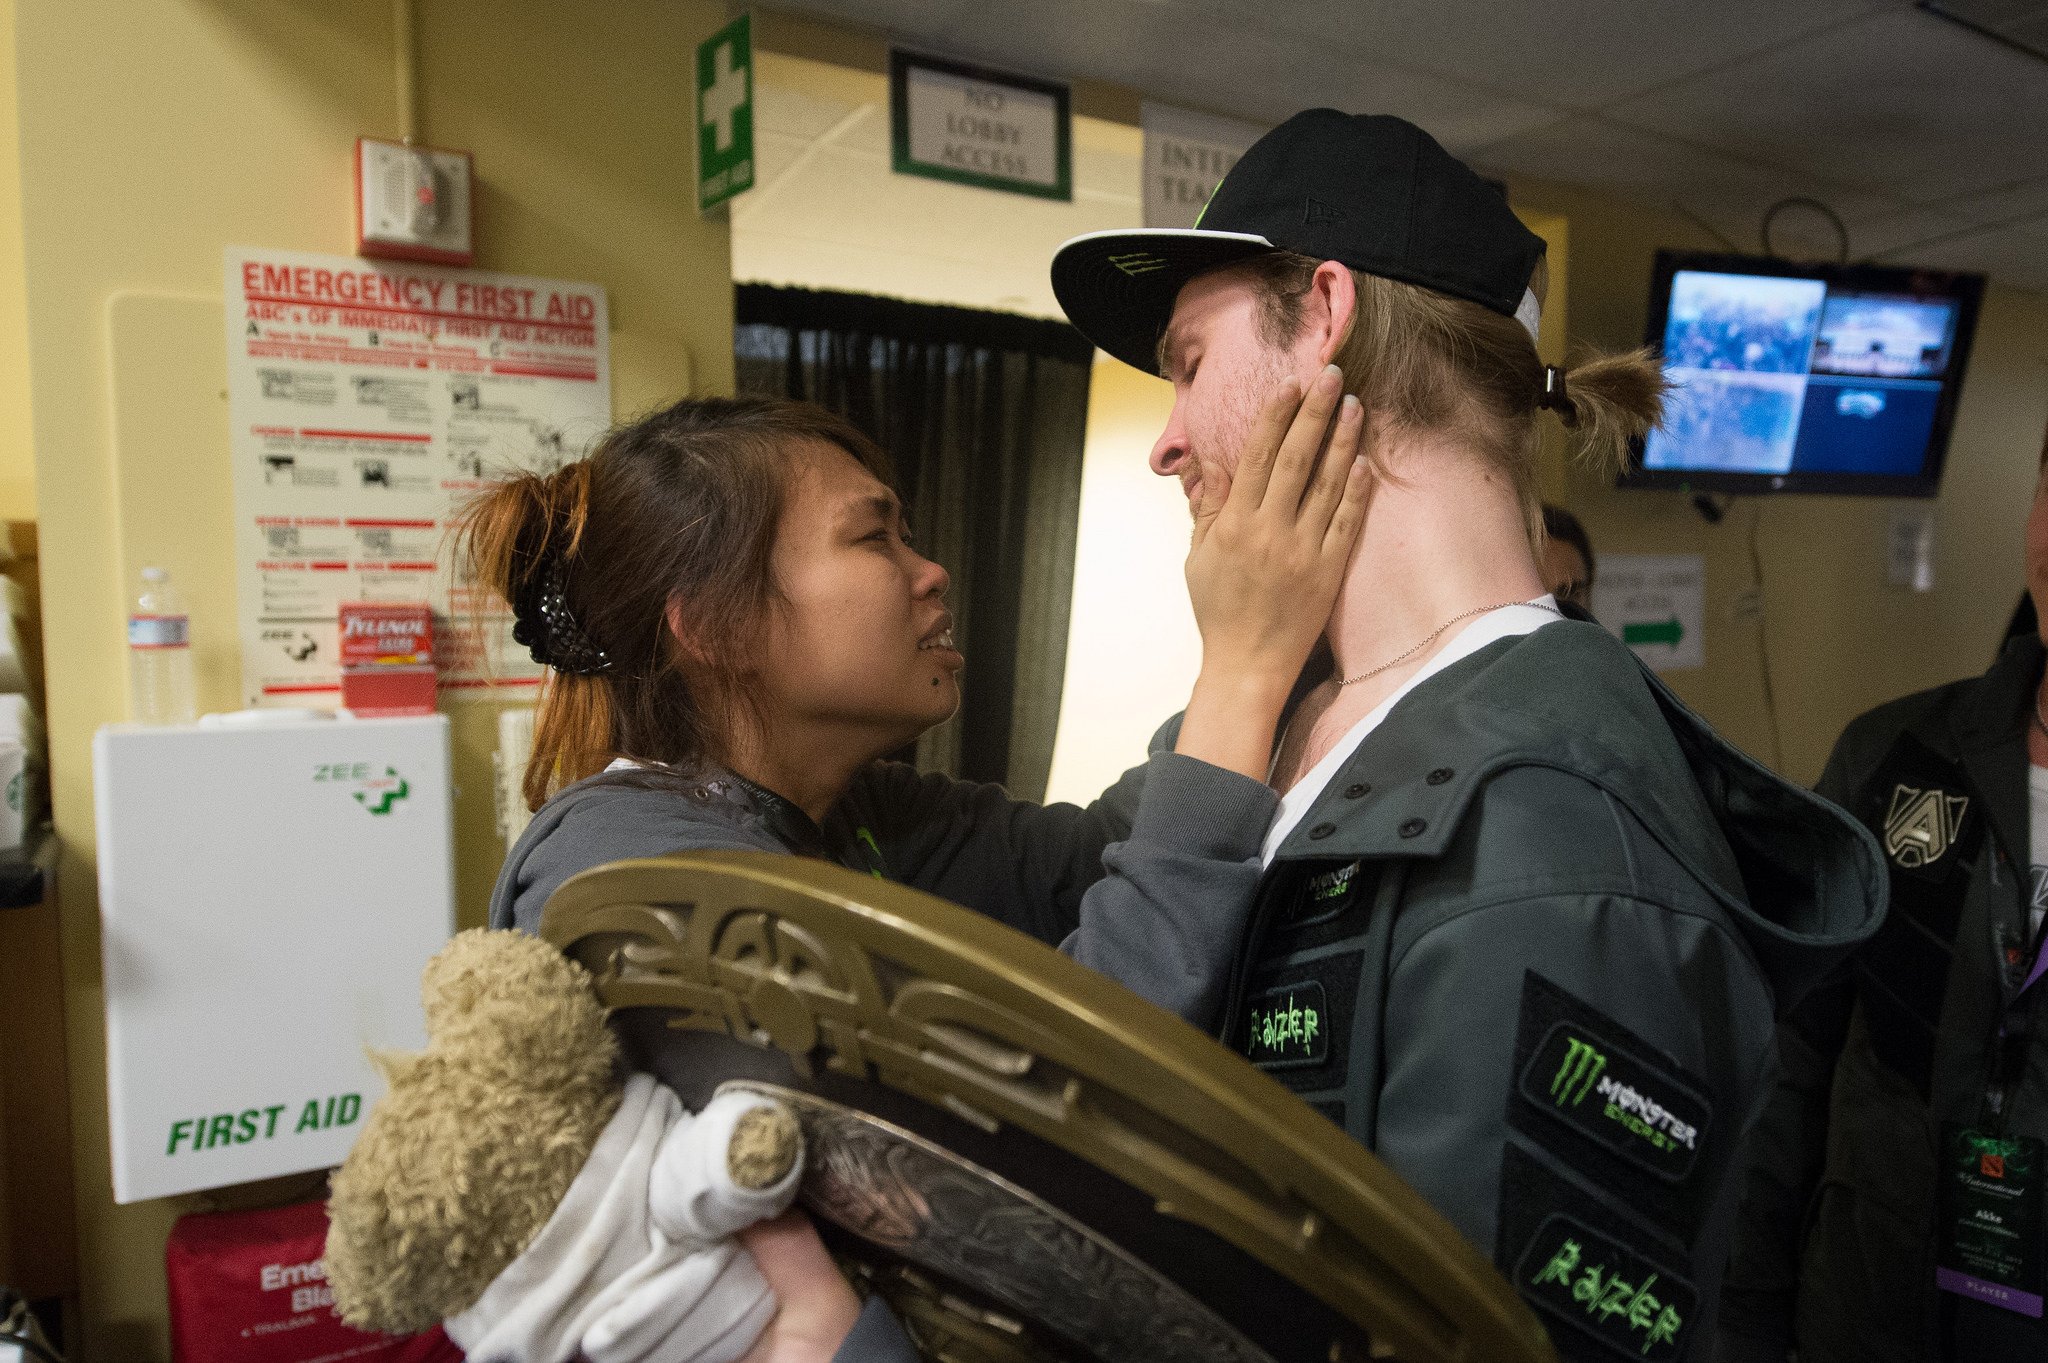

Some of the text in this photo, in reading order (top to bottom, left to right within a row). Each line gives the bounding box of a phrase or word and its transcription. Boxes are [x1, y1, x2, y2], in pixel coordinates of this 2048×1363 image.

[963, 86, 1005, 112] NO
[946, 112, 1022, 146] LOBBY
[941, 142, 1027, 175] ACCESS
[1160, 174, 1213, 203] TEA
[243, 261, 595, 325] EMERGENCY FIRST AID
[247, 320, 259, 337] A
[308, 308, 333, 325] OF
[338, 311, 440, 338] IMMEDIATE
[445, 321, 491, 341] FIRST
[535, 330, 595, 348] ACTION
[344, 614, 424, 637] TYLENOL
[313, 763, 368, 782] ZEE
[166, 1091, 362, 1157] FIRST AID
[1596, 1074, 1697, 1151] MONSTER
[1603, 1103, 1679, 1153] ENERGY
[261, 1260, 327, 1292] Eme
[1966, 1280, 2009, 1301] PLAYER
[291, 1286, 333, 1313] Bla
